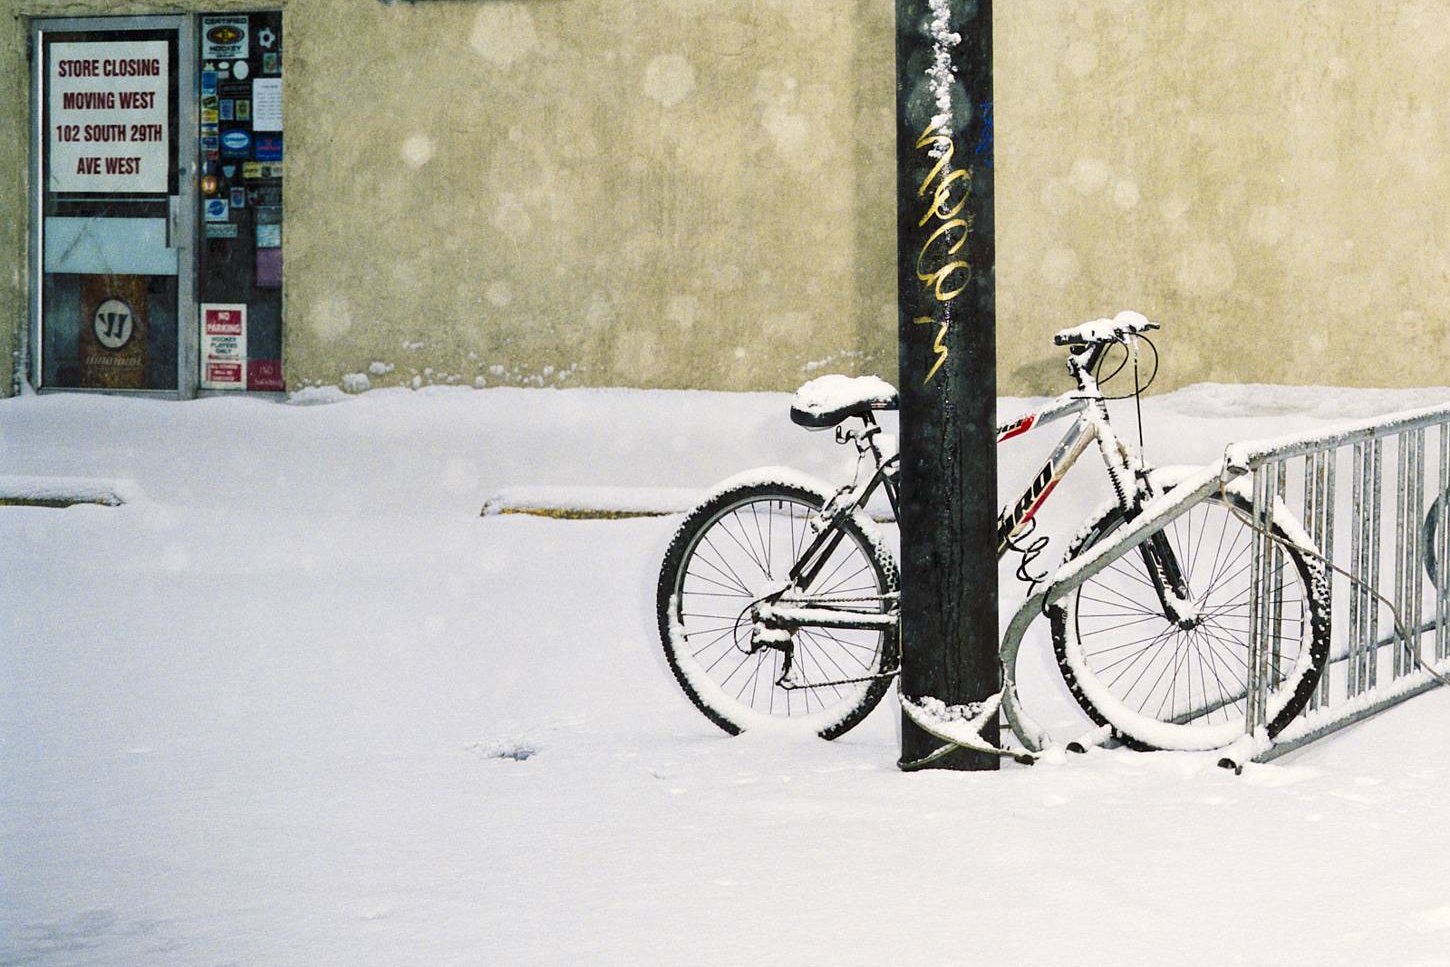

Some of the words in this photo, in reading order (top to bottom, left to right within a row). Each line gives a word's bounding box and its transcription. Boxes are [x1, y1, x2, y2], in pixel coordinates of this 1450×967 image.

[58, 59, 100, 78] STORE
[103, 58, 160, 77] CLOSING
[63, 92, 115, 110] MOVING
[118, 91, 156, 109] WEST
[56, 124, 80, 142] 102
[84, 124, 126, 142] SOUTH
[130, 124, 162, 142] 29TH
[76, 157, 101, 175] AVE
[105, 157, 141, 175] WEST
